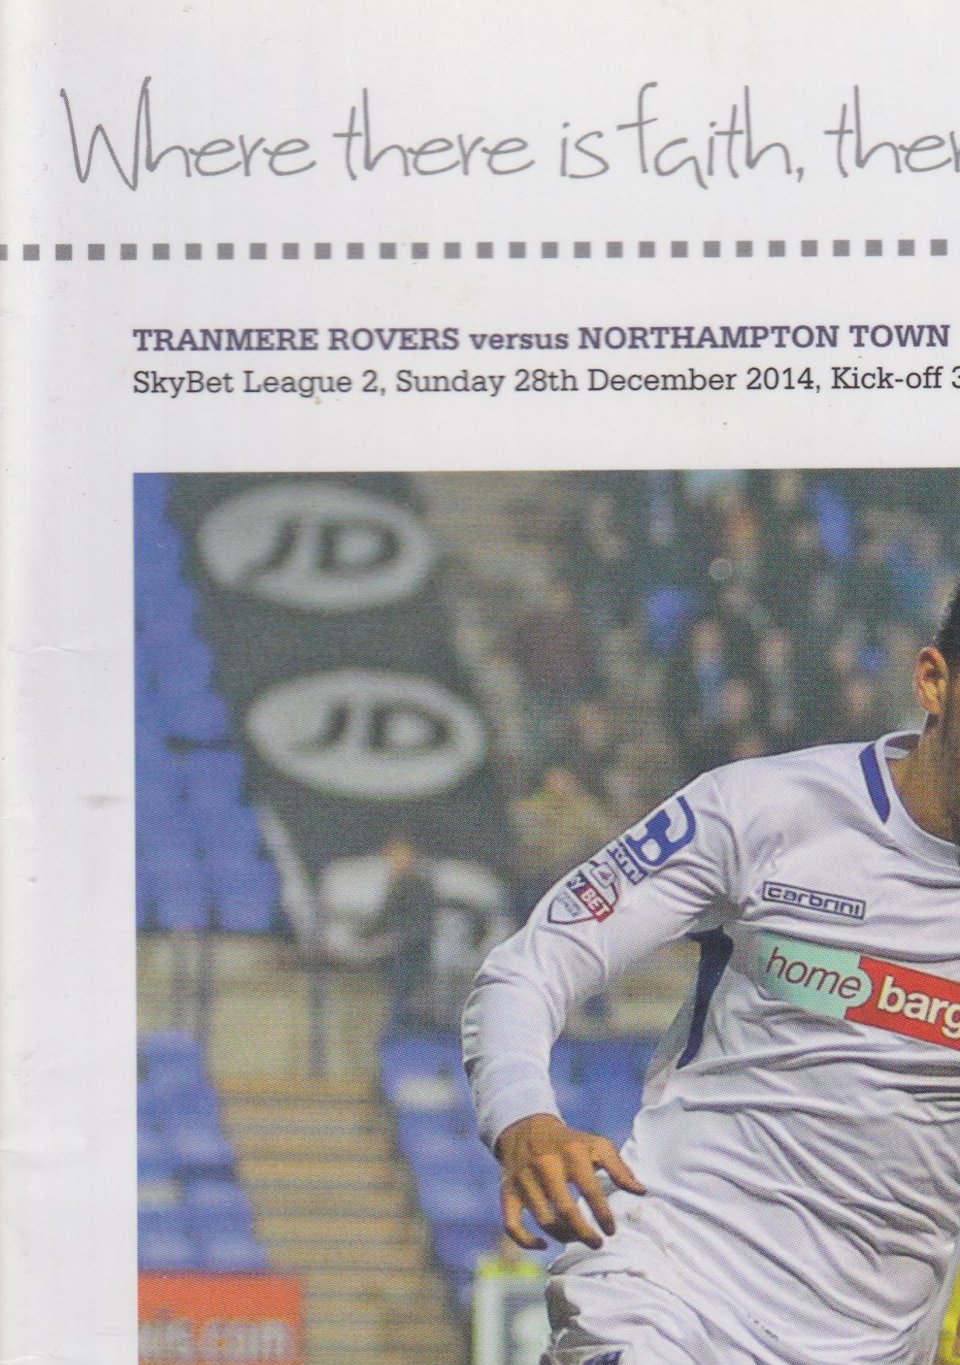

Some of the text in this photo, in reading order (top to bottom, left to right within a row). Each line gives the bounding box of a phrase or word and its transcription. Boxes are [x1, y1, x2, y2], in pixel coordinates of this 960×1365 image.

[61, 77, 315, 191] Where
[333, 87, 535, 180] there
[560, 121, 609, 178] is
[617, 82, 804, 190] faith,
[134, 325, 951, 352] TRANMERE ROVERS versus NORTHAMPTON TOWN
[134, 370, 235, 400] SkyBet
[244, 370, 353, 401] League
[363, 369, 386, 396] 2,
[397, 369, 507, 398] Sunday
[516, 368, 579, 394] 28th
[588, 368, 738, 392] December
[747, 367, 821, 394] 2014,
[832, 366, 945, 390] Kick-off
[767, 886, 862, 916] carbrini
[766, 947, 862, 999] home
